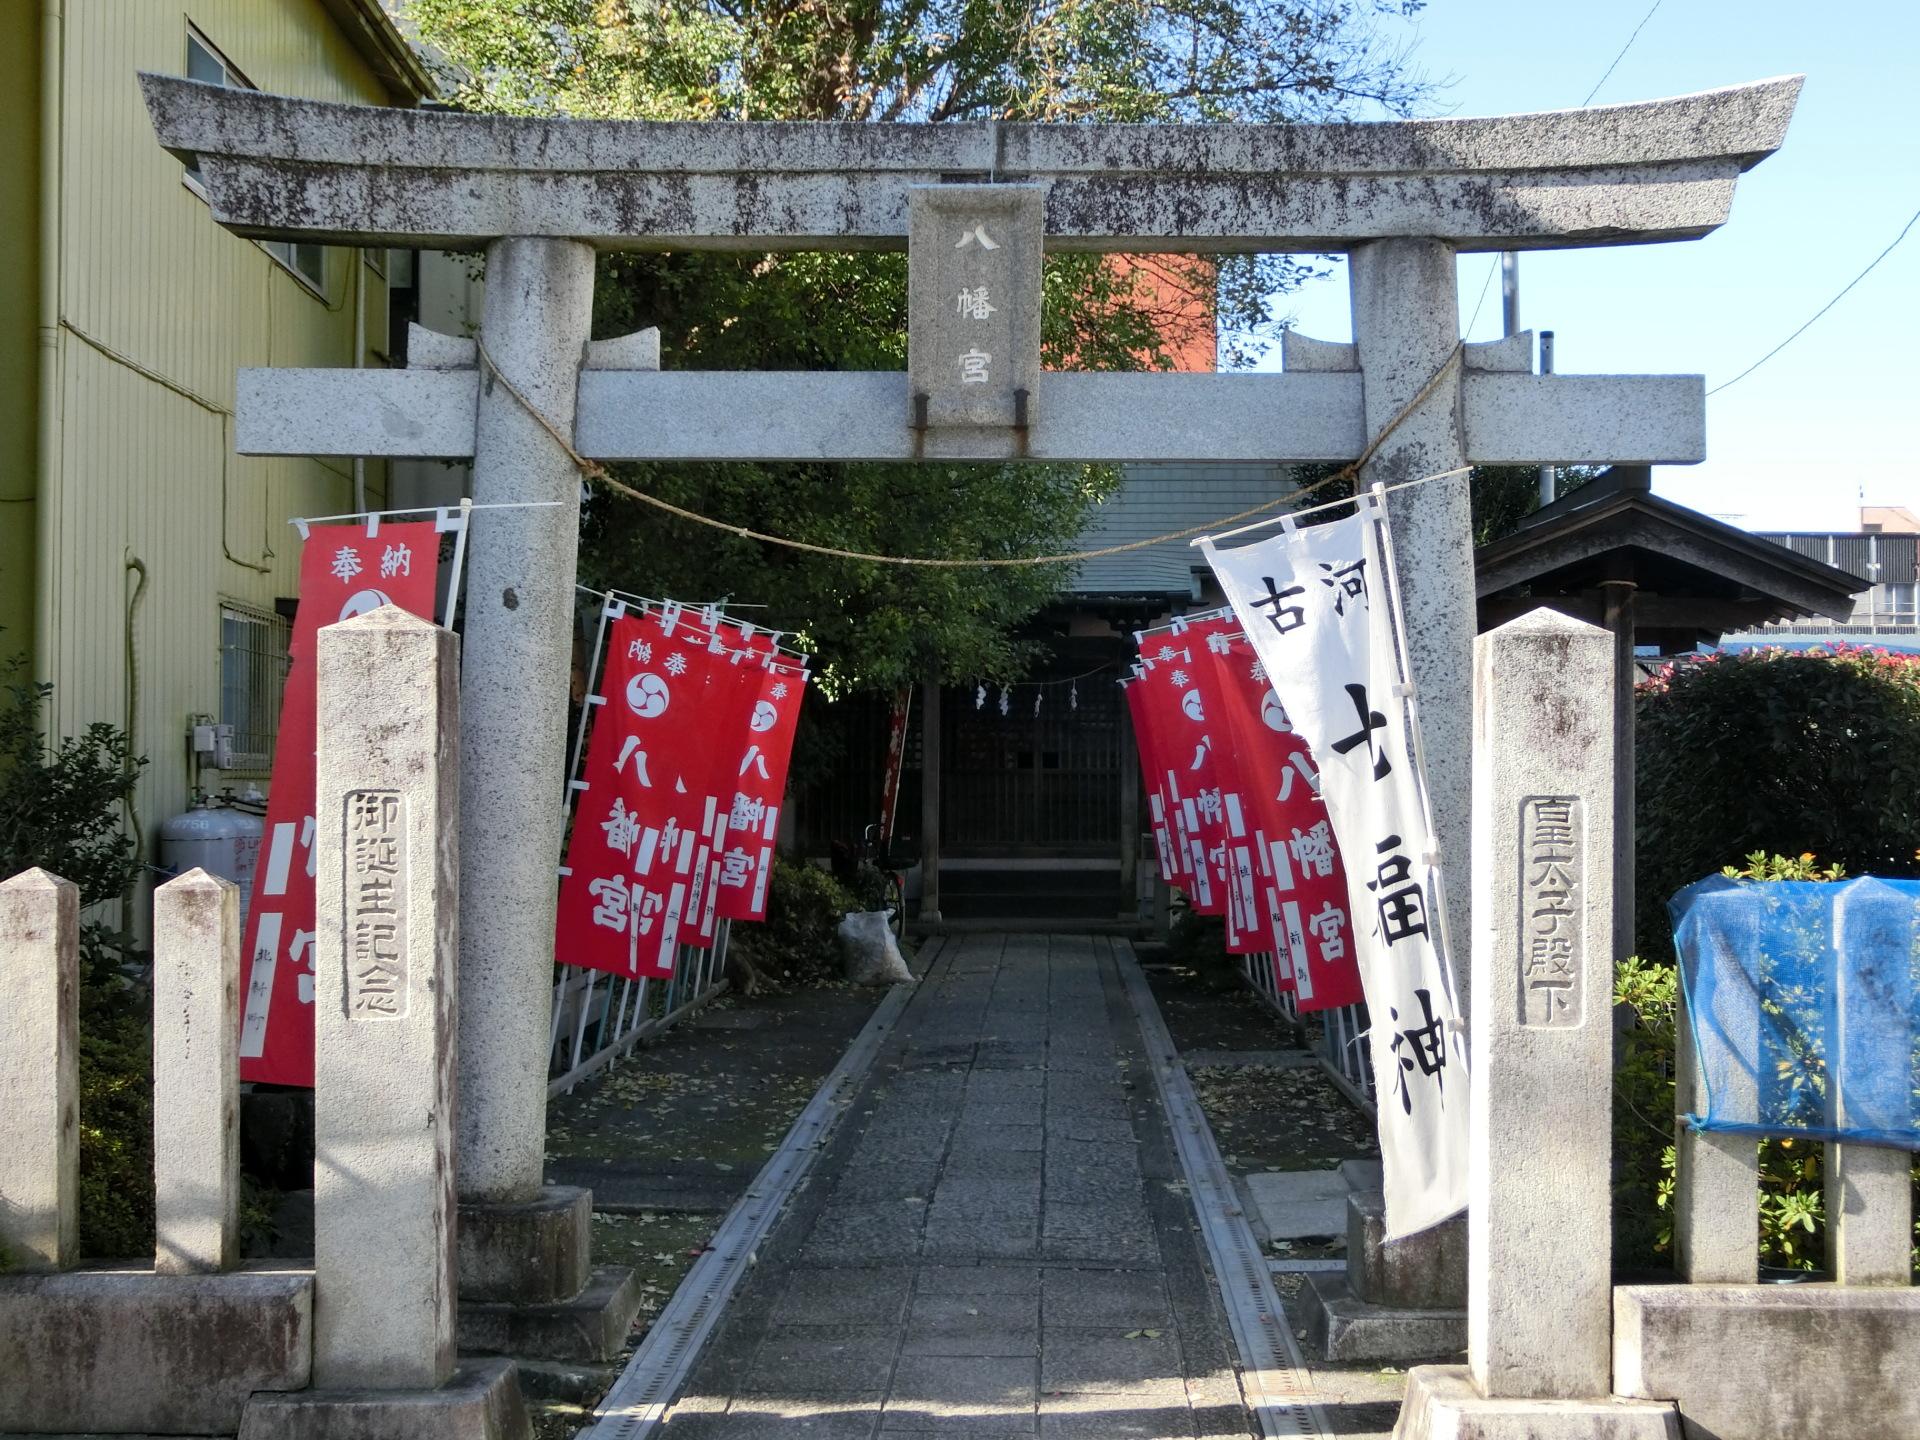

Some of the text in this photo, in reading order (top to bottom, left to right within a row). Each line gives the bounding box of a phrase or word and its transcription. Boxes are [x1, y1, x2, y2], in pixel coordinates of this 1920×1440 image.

[954, 224, 1000, 383] 八幡宮
[331, 543, 412, 584] 奉納
[1250, 558, 1369, 635] 古河
[354, 793, 399, 1014] 御誕生記念
[1275, 752, 1345, 962] 八幡宮
[1525, 799, 1574, 1023] 皇太子殿下
